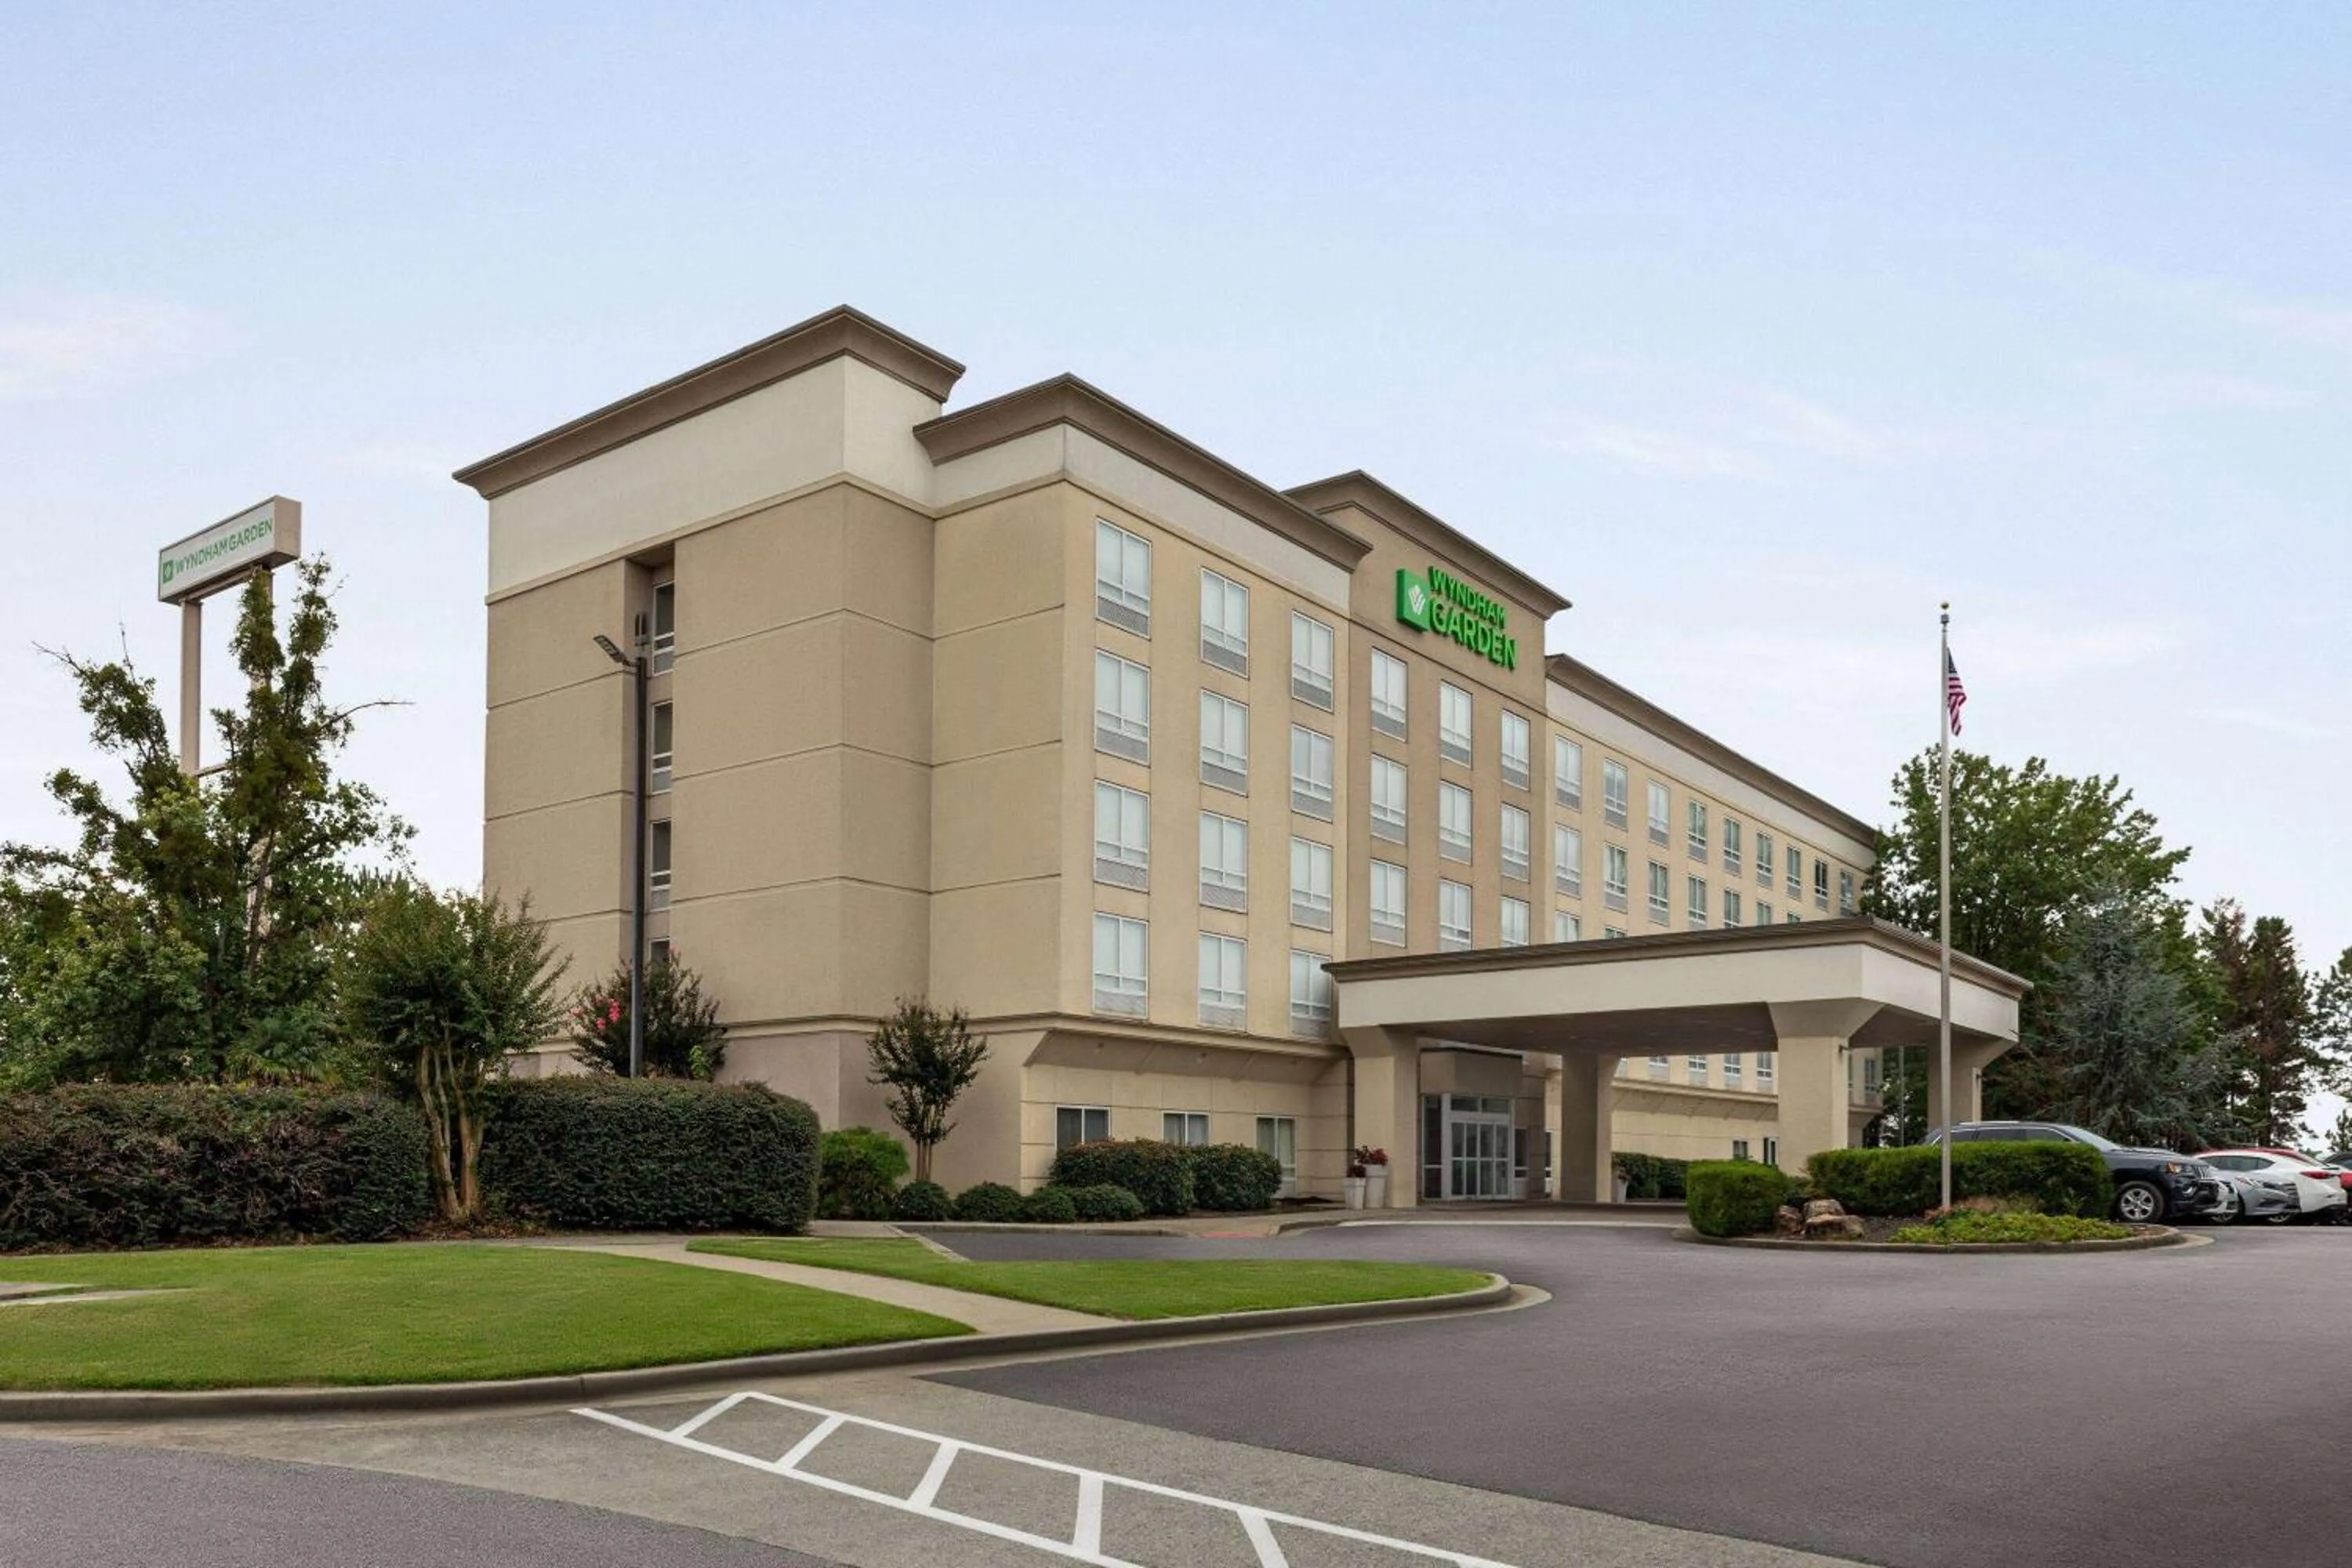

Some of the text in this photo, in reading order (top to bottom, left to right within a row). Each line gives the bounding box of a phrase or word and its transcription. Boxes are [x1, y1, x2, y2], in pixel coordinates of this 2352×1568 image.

[174, 519, 272, 573] WYNDHAM GARDEN
[1428, 566, 1506, 628] WYNDHAM
[1430, 598, 1516, 671] GARDEN
